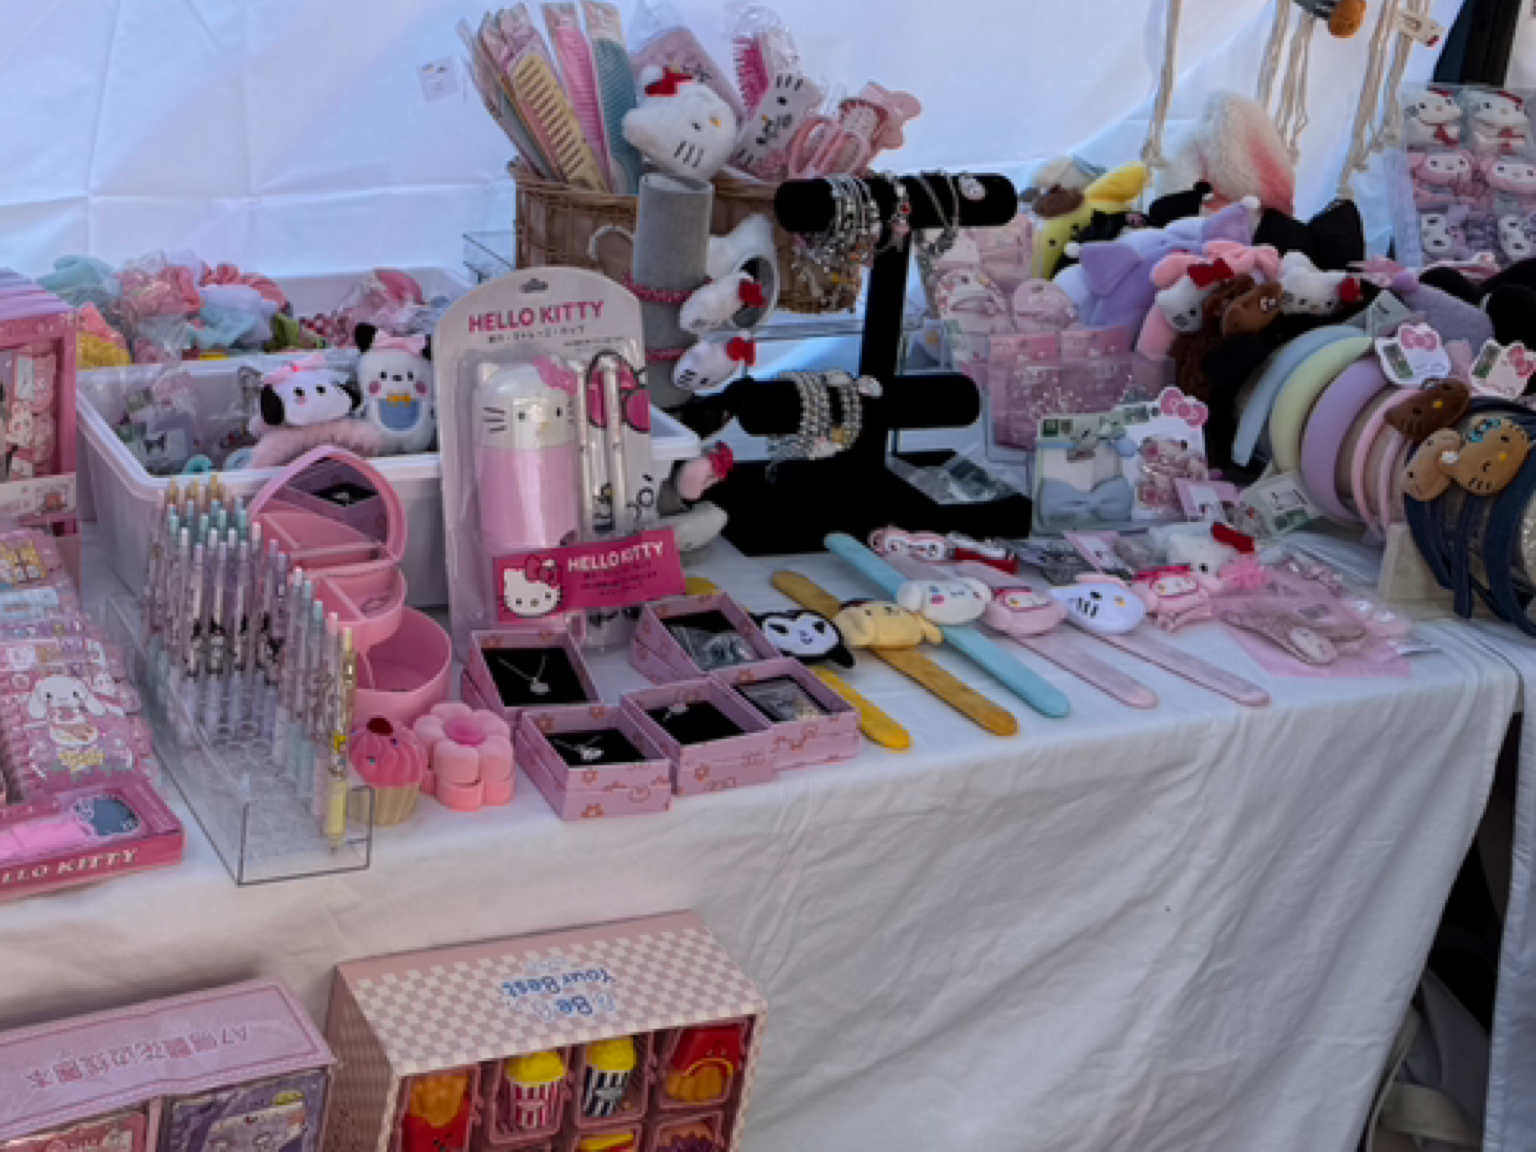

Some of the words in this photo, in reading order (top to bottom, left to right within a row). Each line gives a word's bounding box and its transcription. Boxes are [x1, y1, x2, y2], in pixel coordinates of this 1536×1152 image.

[468, 307, 535, 334] HELLO
[539, 298, 605, 324] KITTY
[567, 550, 619, 573] HELLO
[621, 540, 664, 564] KITTY
[56, 846, 140, 875] KITTY
[501, 974, 562, 998] Best
[563, 967, 616, 988] Your
[555, 994, 594, 1016] Be
